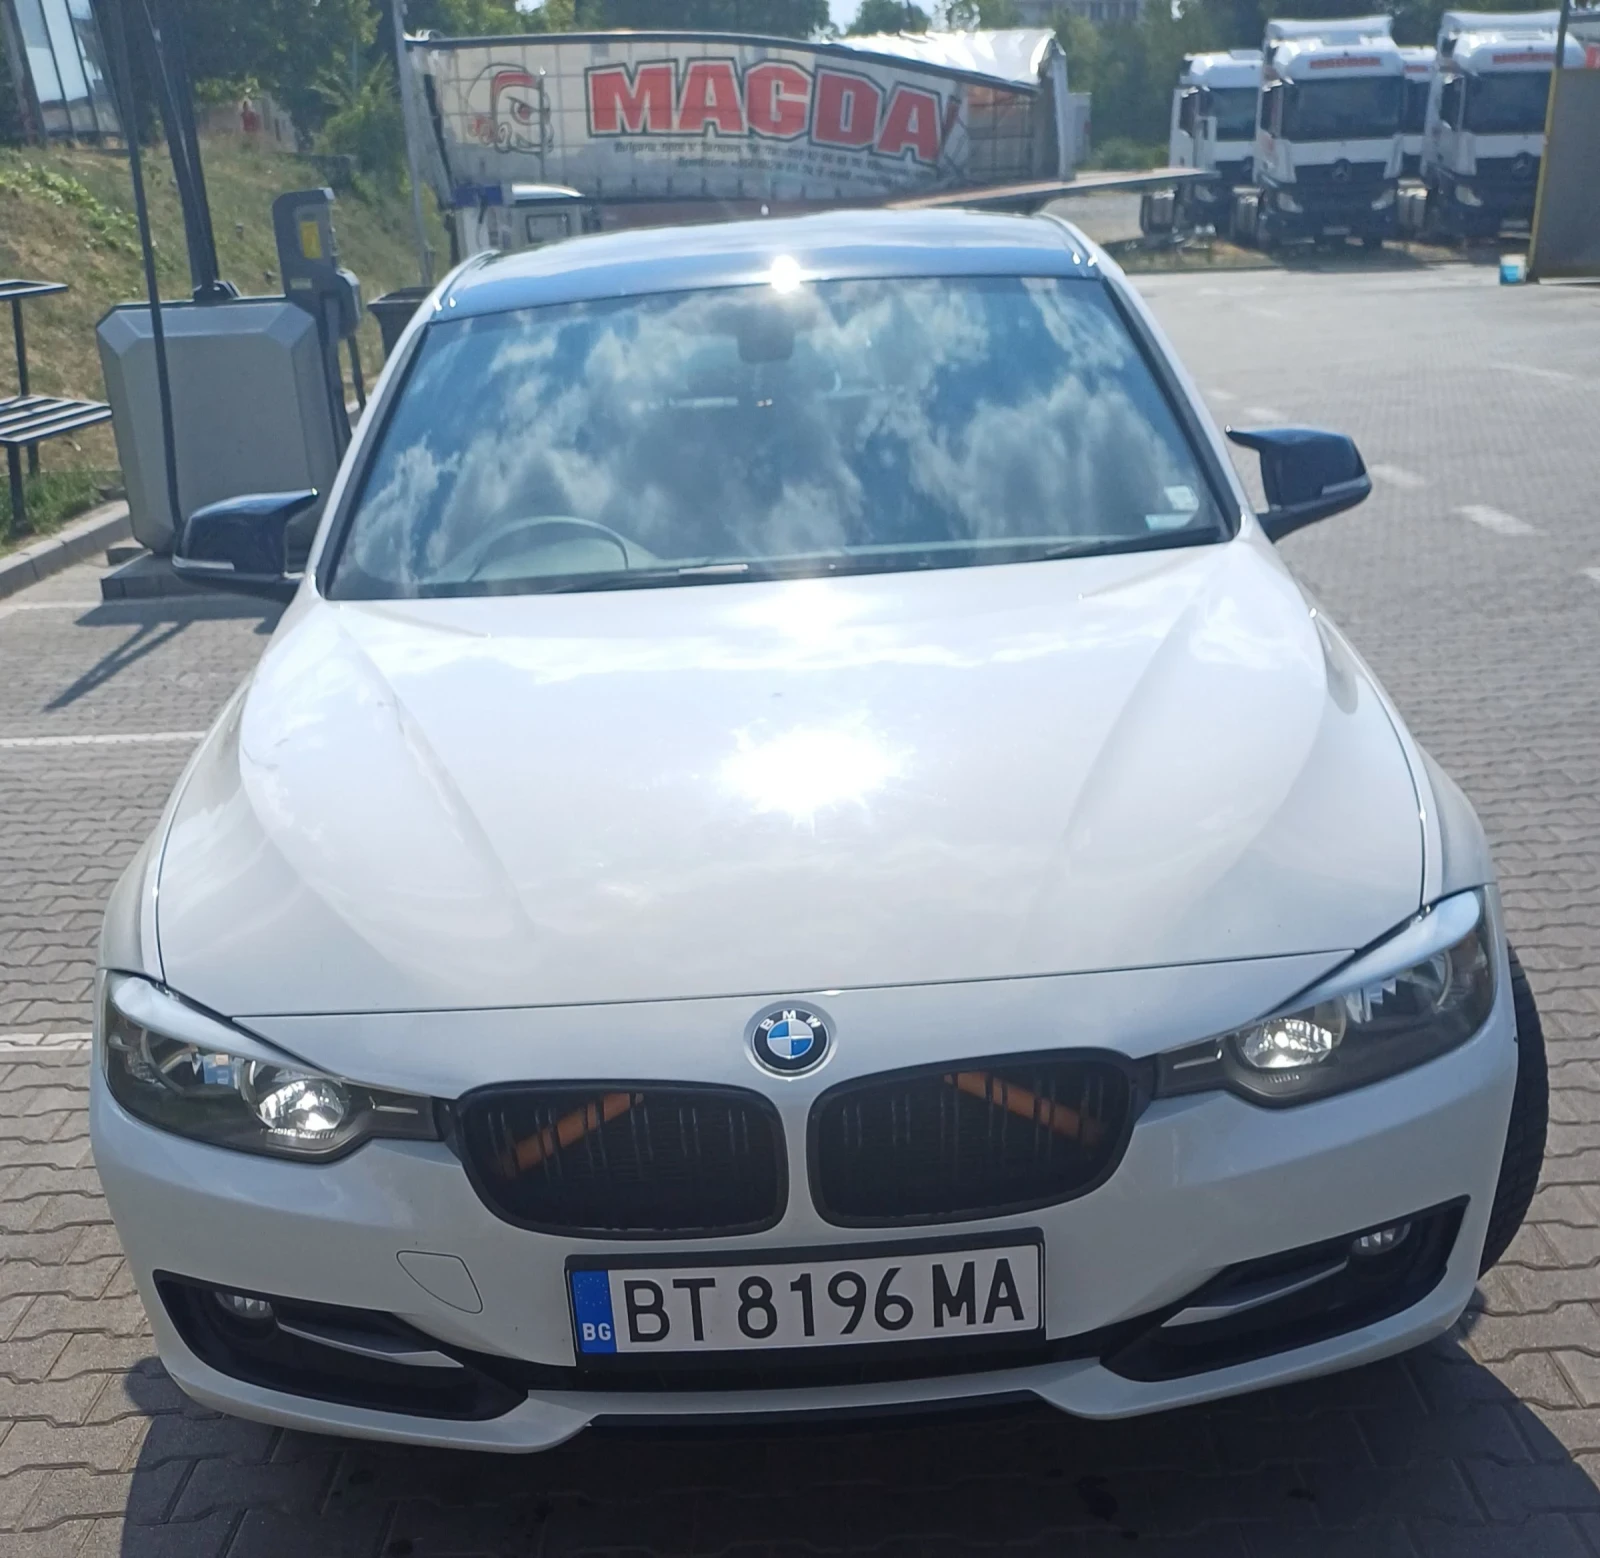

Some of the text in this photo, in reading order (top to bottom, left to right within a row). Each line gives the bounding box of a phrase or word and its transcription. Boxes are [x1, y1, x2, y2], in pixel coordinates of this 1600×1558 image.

[585, 57, 942, 165] MAGDA
[760, 1010, 821, 1030] BMW
[624, 1258, 1025, 1342] BT 8196 MA
[582, 1322, 611, 1341] BG
